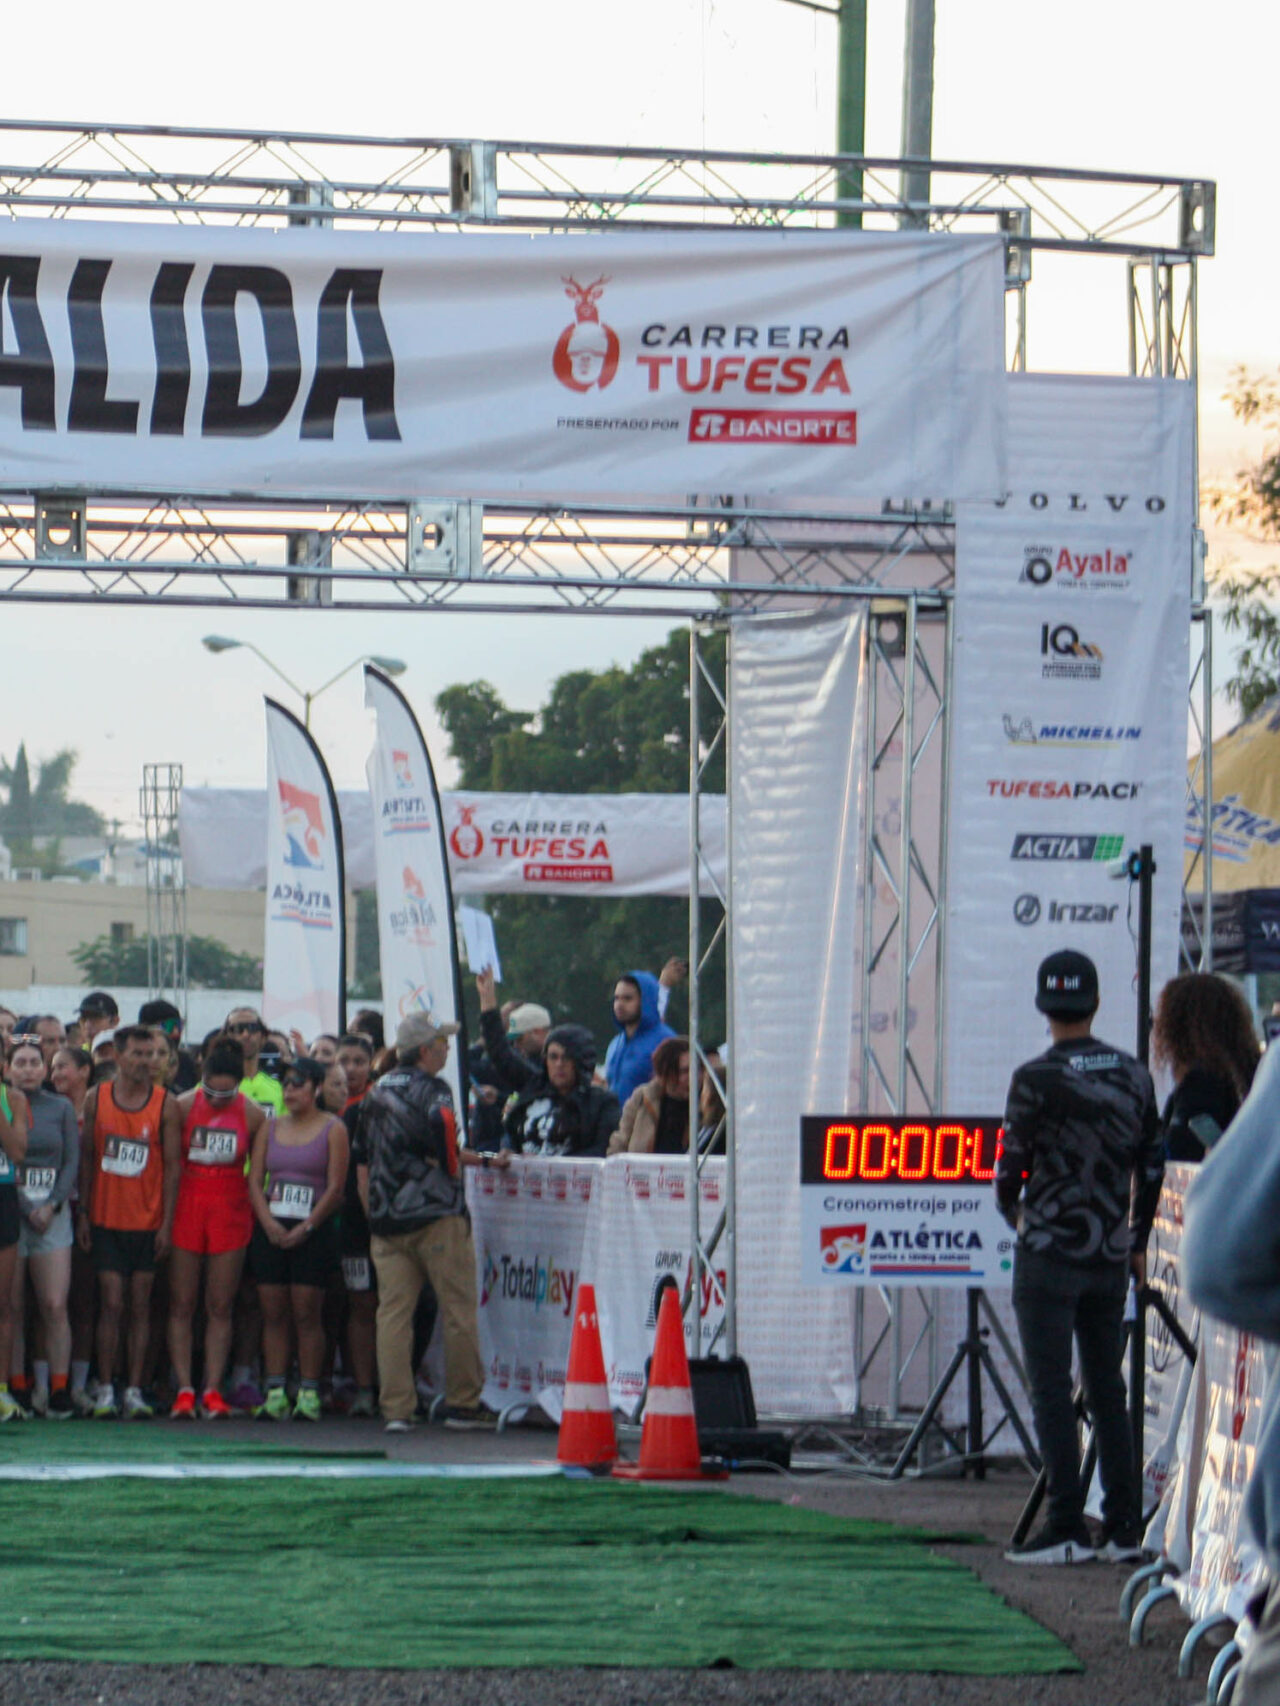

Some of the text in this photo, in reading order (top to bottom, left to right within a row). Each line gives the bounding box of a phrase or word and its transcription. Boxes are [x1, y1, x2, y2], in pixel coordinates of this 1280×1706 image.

[640, 323, 851, 350] CARRERA
[636, 356, 852, 395] TUFESA
[556, 416, 680, 431] PRESENTADO POR
[728, 418, 852, 438] BANORTE
[1056, 546, 1128, 579] Ayala
[1041, 623, 1080, 657] IQ
[1039, 724, 1143, 740] MICHELIN
[491, 820, 608, 834] CARRERA
[490, 836, 609, 860] TUFESA
[1017, 836, 1081, 858] ACTIA
[1048, 901, 1119, 923] Irizar
[1046, 975, 1081, 990] Mobil
[823, 1195, 981, 1216] Cronometraje por
[500, 1253, 574, 1317] Totalplay
